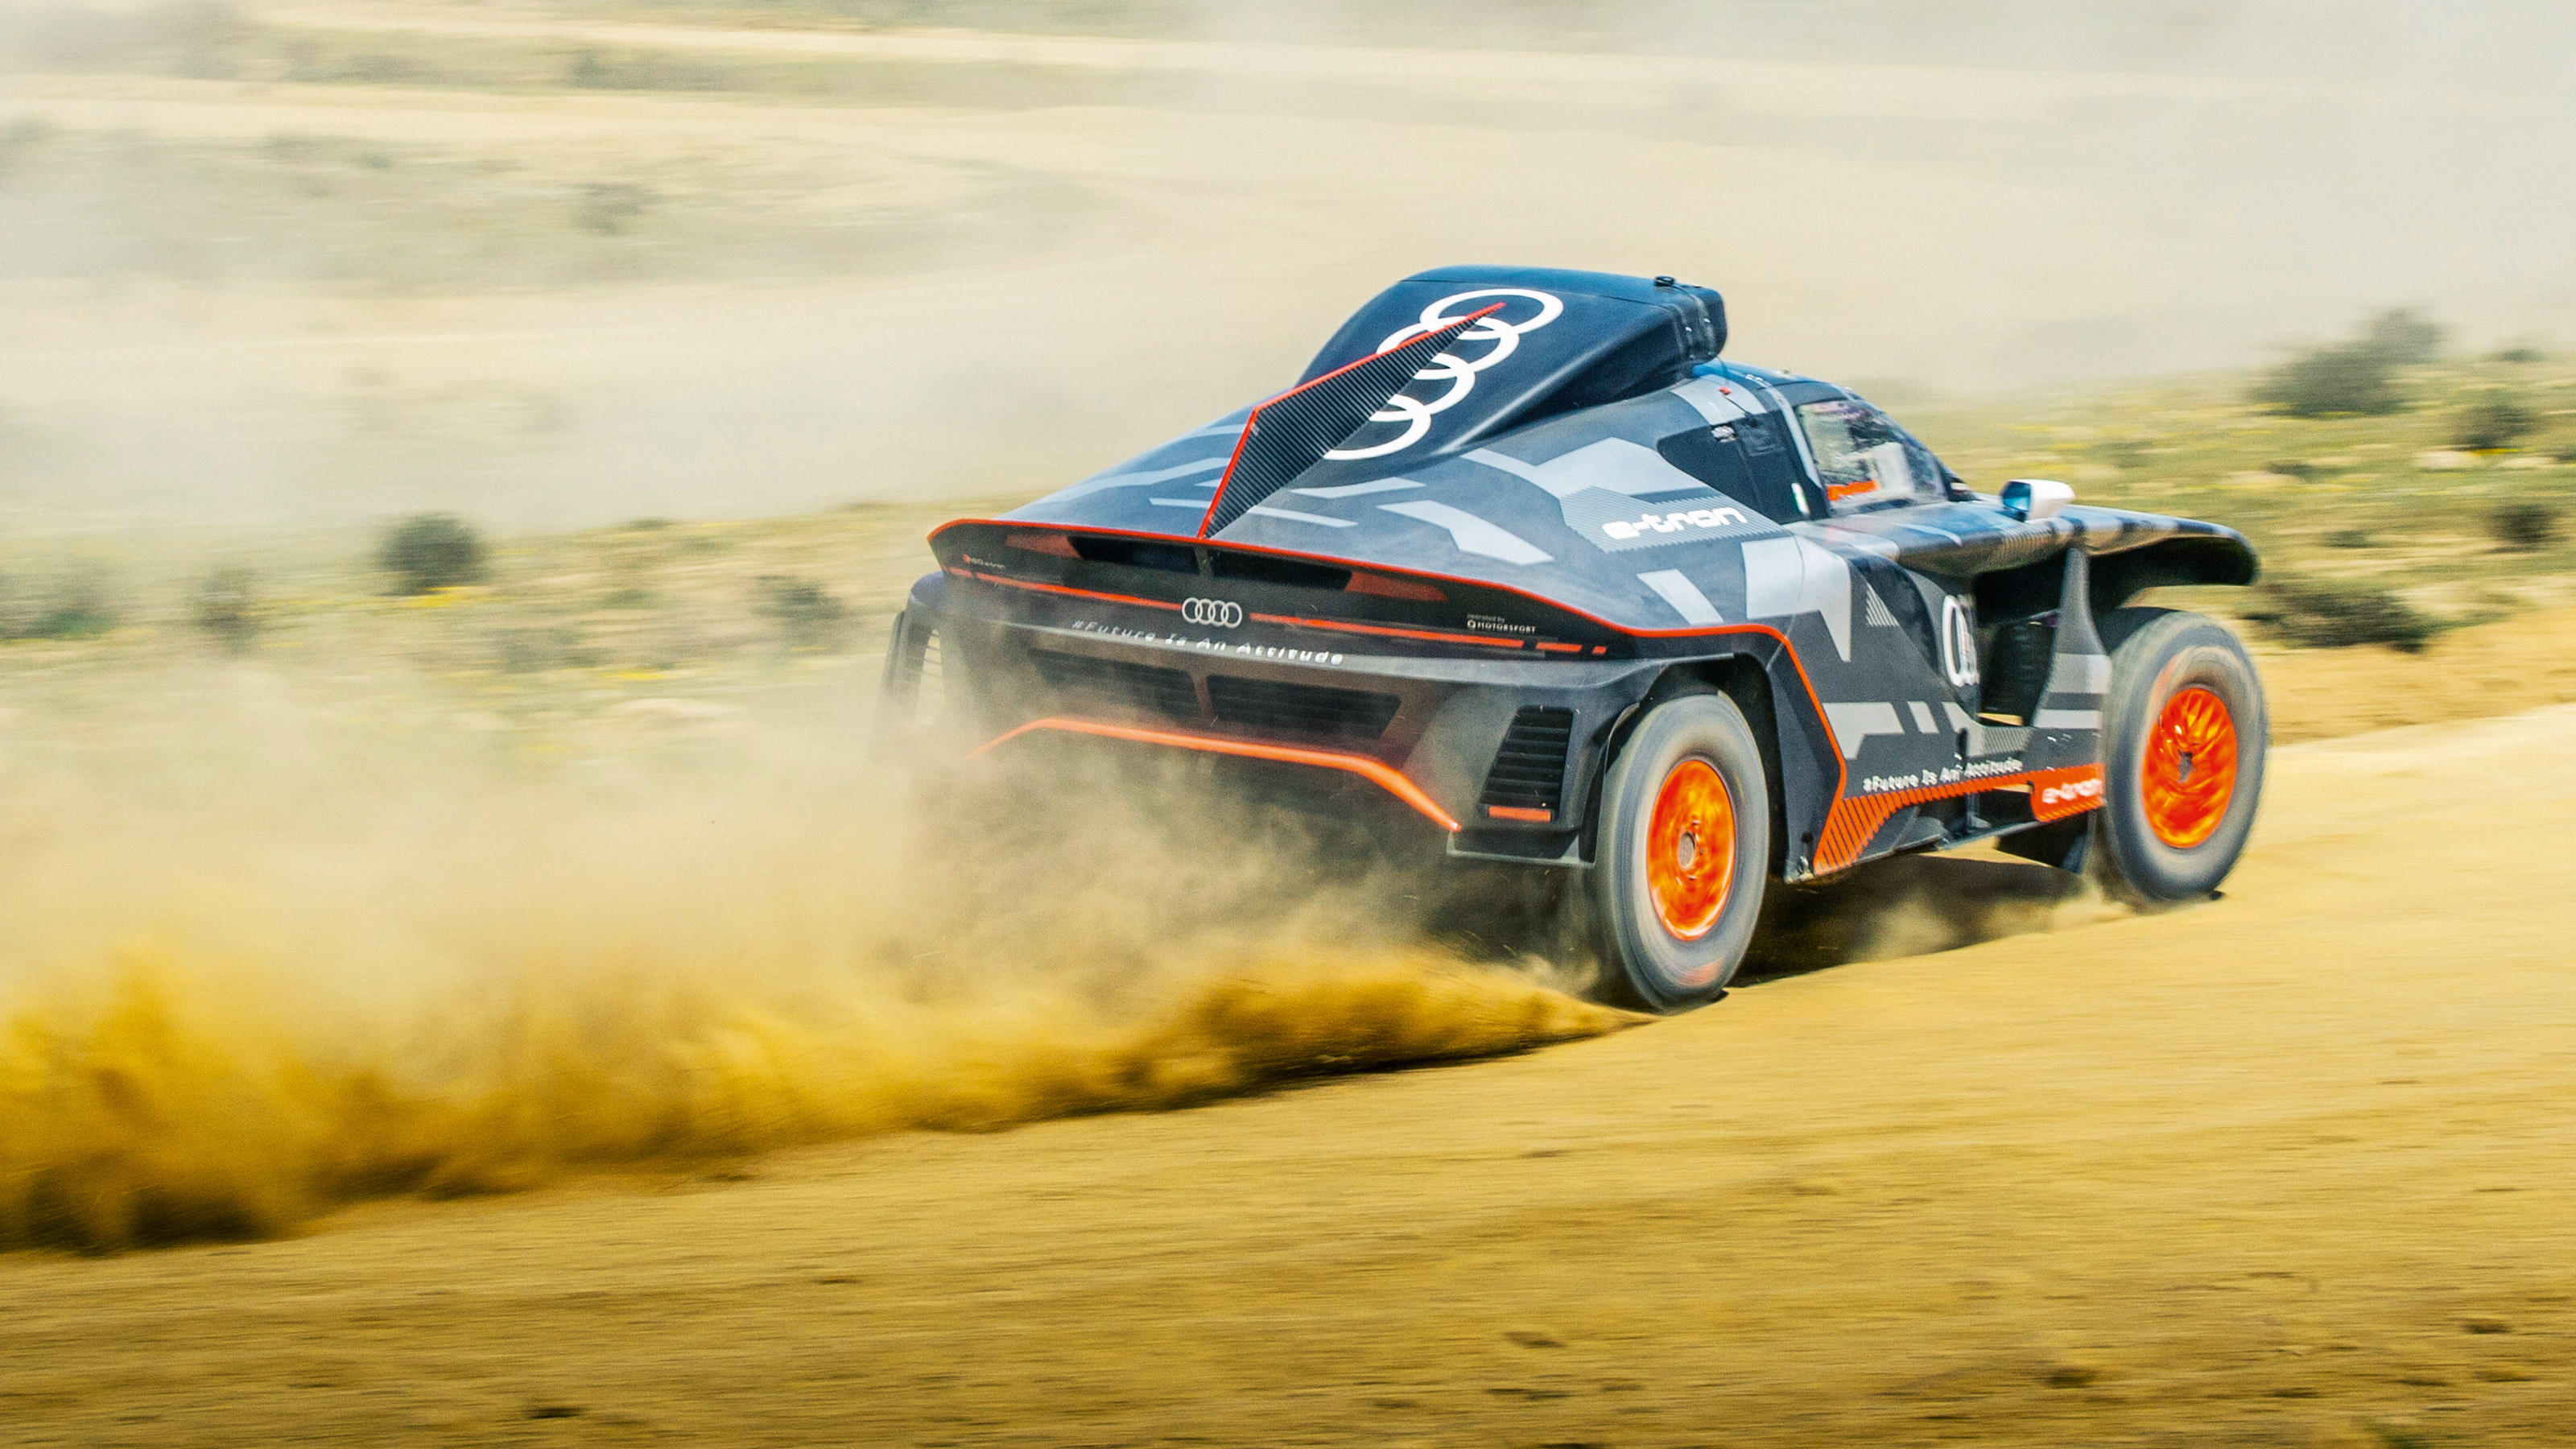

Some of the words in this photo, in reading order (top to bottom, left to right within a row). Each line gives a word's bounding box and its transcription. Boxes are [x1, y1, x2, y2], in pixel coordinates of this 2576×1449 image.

[1602, 506, 1748, 539] e-tron
[1477, 621, 1537, 634] MOTORSPORT
[1071, 620, 1156, 642] #Future
[1165, 633, 1188, 646] Is
[1236, 642, 1344, 665] Attitude
[1863, 774, 1919, 792] #Future
